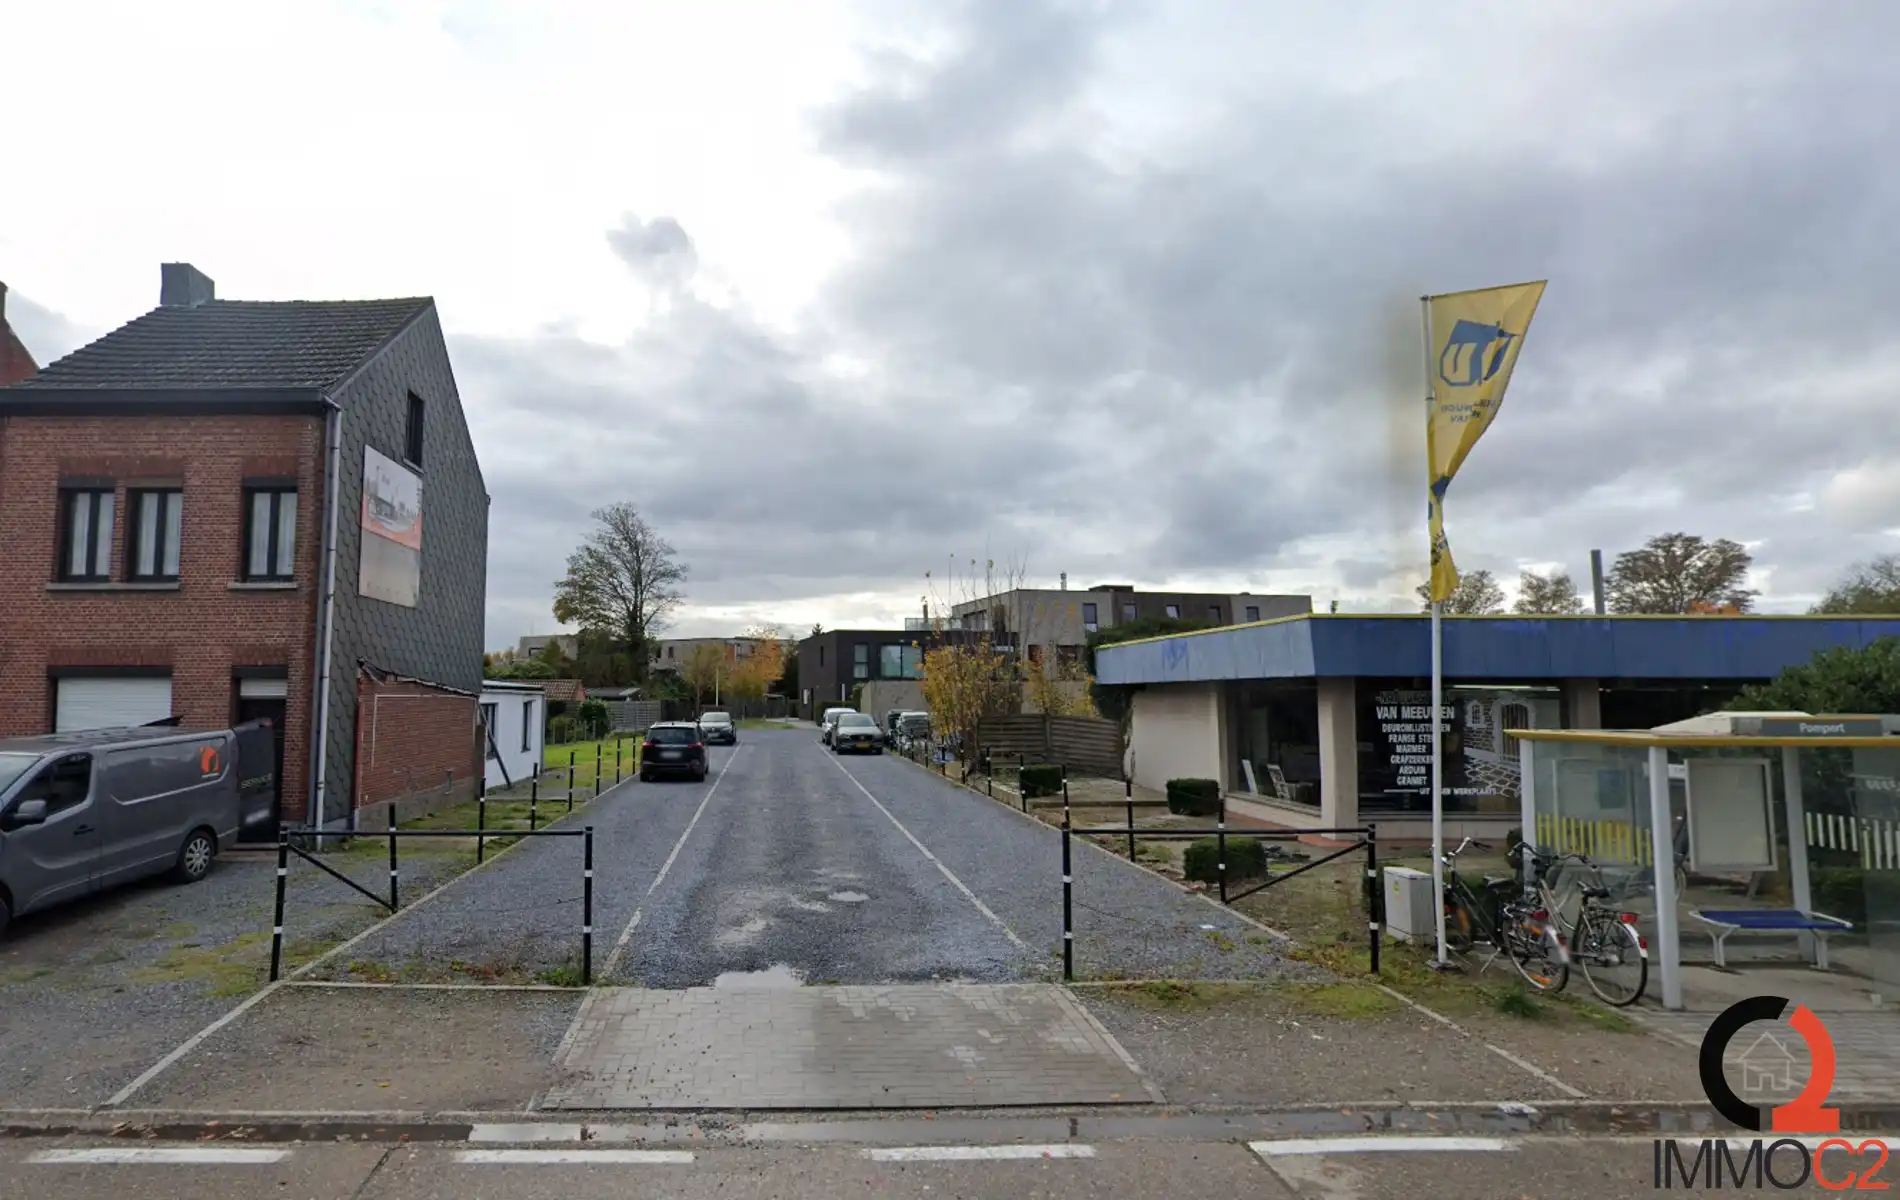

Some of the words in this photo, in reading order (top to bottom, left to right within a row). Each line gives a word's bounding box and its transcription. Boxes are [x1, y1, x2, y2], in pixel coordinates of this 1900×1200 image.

[1376, 706, 1397, 719] VAN
[1401, 706, 1455, 719] MEEUEN
[1382, 723, 1451, 733] DEUROMLIJSTIEN
[1388, 734, 1416, 743] FRANSE
[1396, 744, 1427, 753] MARMER
[1399, 766, 1426, 775] ARDUIN
